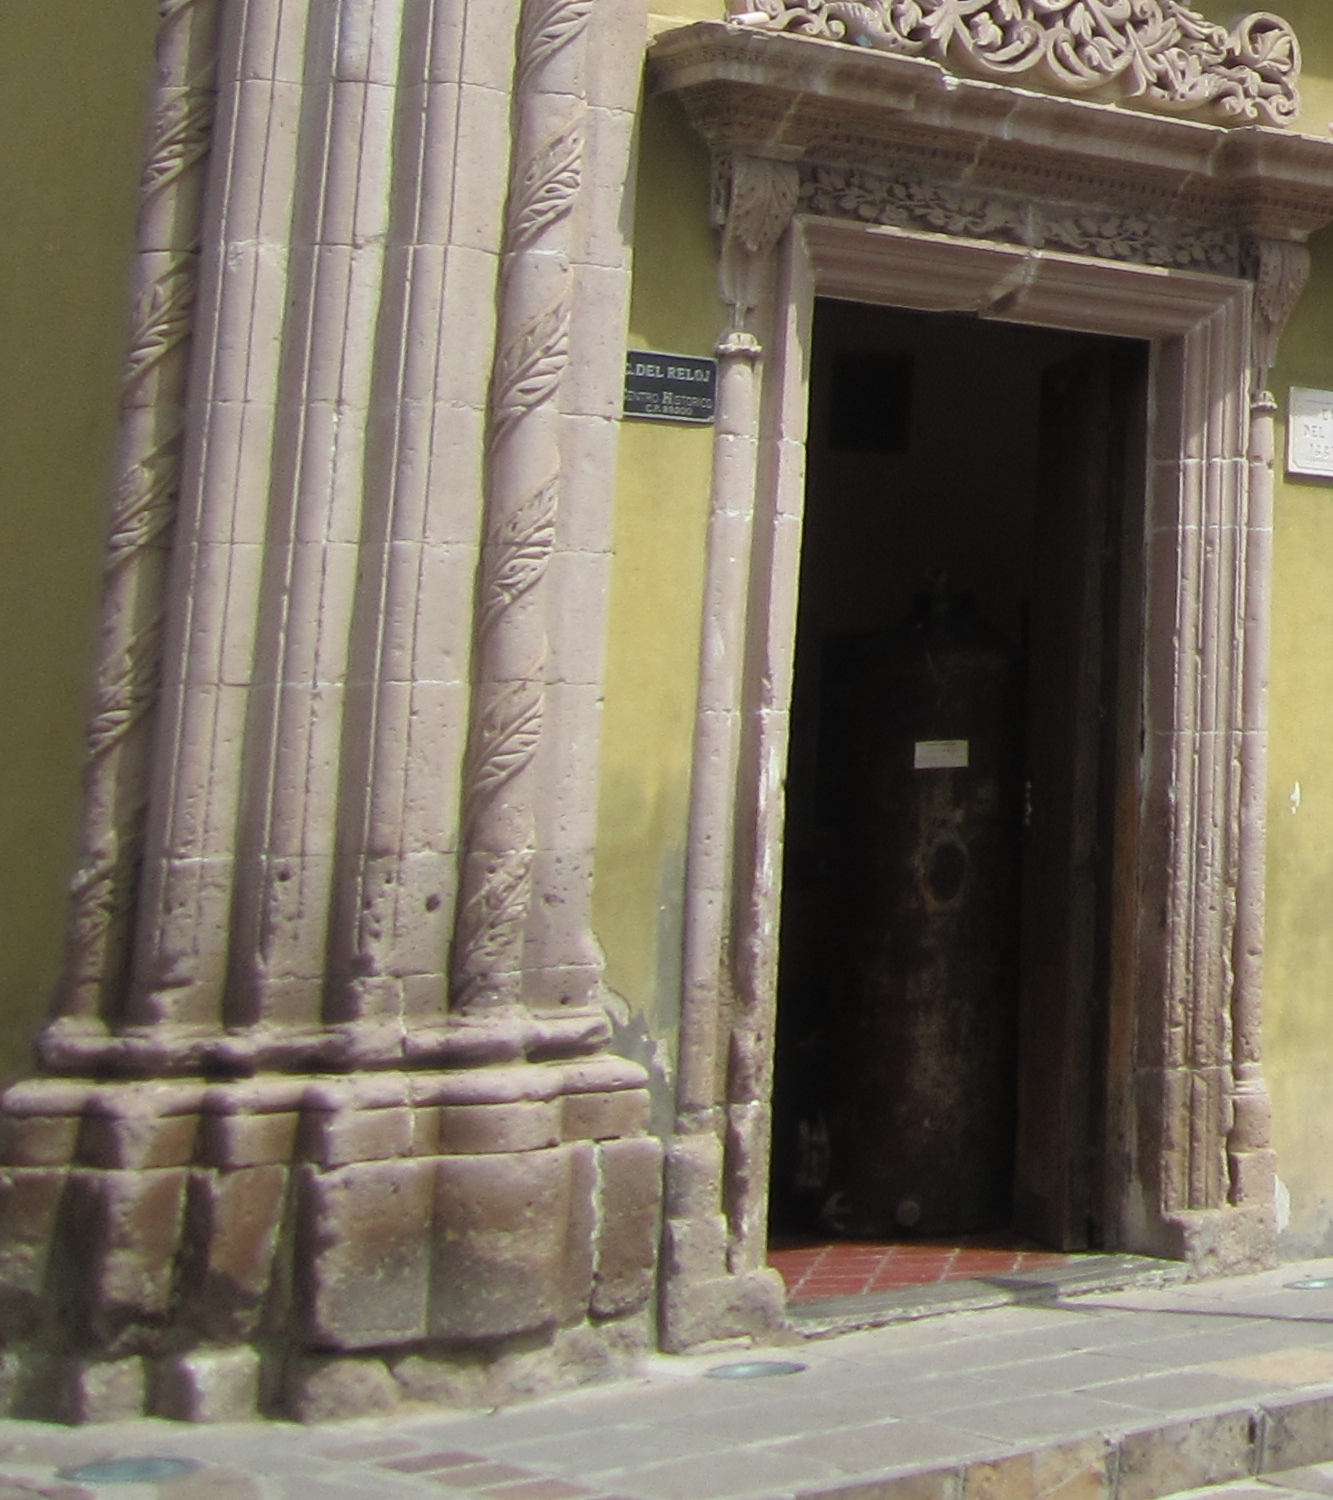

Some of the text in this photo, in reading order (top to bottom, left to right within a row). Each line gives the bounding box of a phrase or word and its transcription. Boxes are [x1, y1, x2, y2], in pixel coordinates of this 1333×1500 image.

[666, 366, 711, 383] RELOJ
[624, 388, 660, 404] ENTRO
[1303, 424, 1325, 439] DEL
